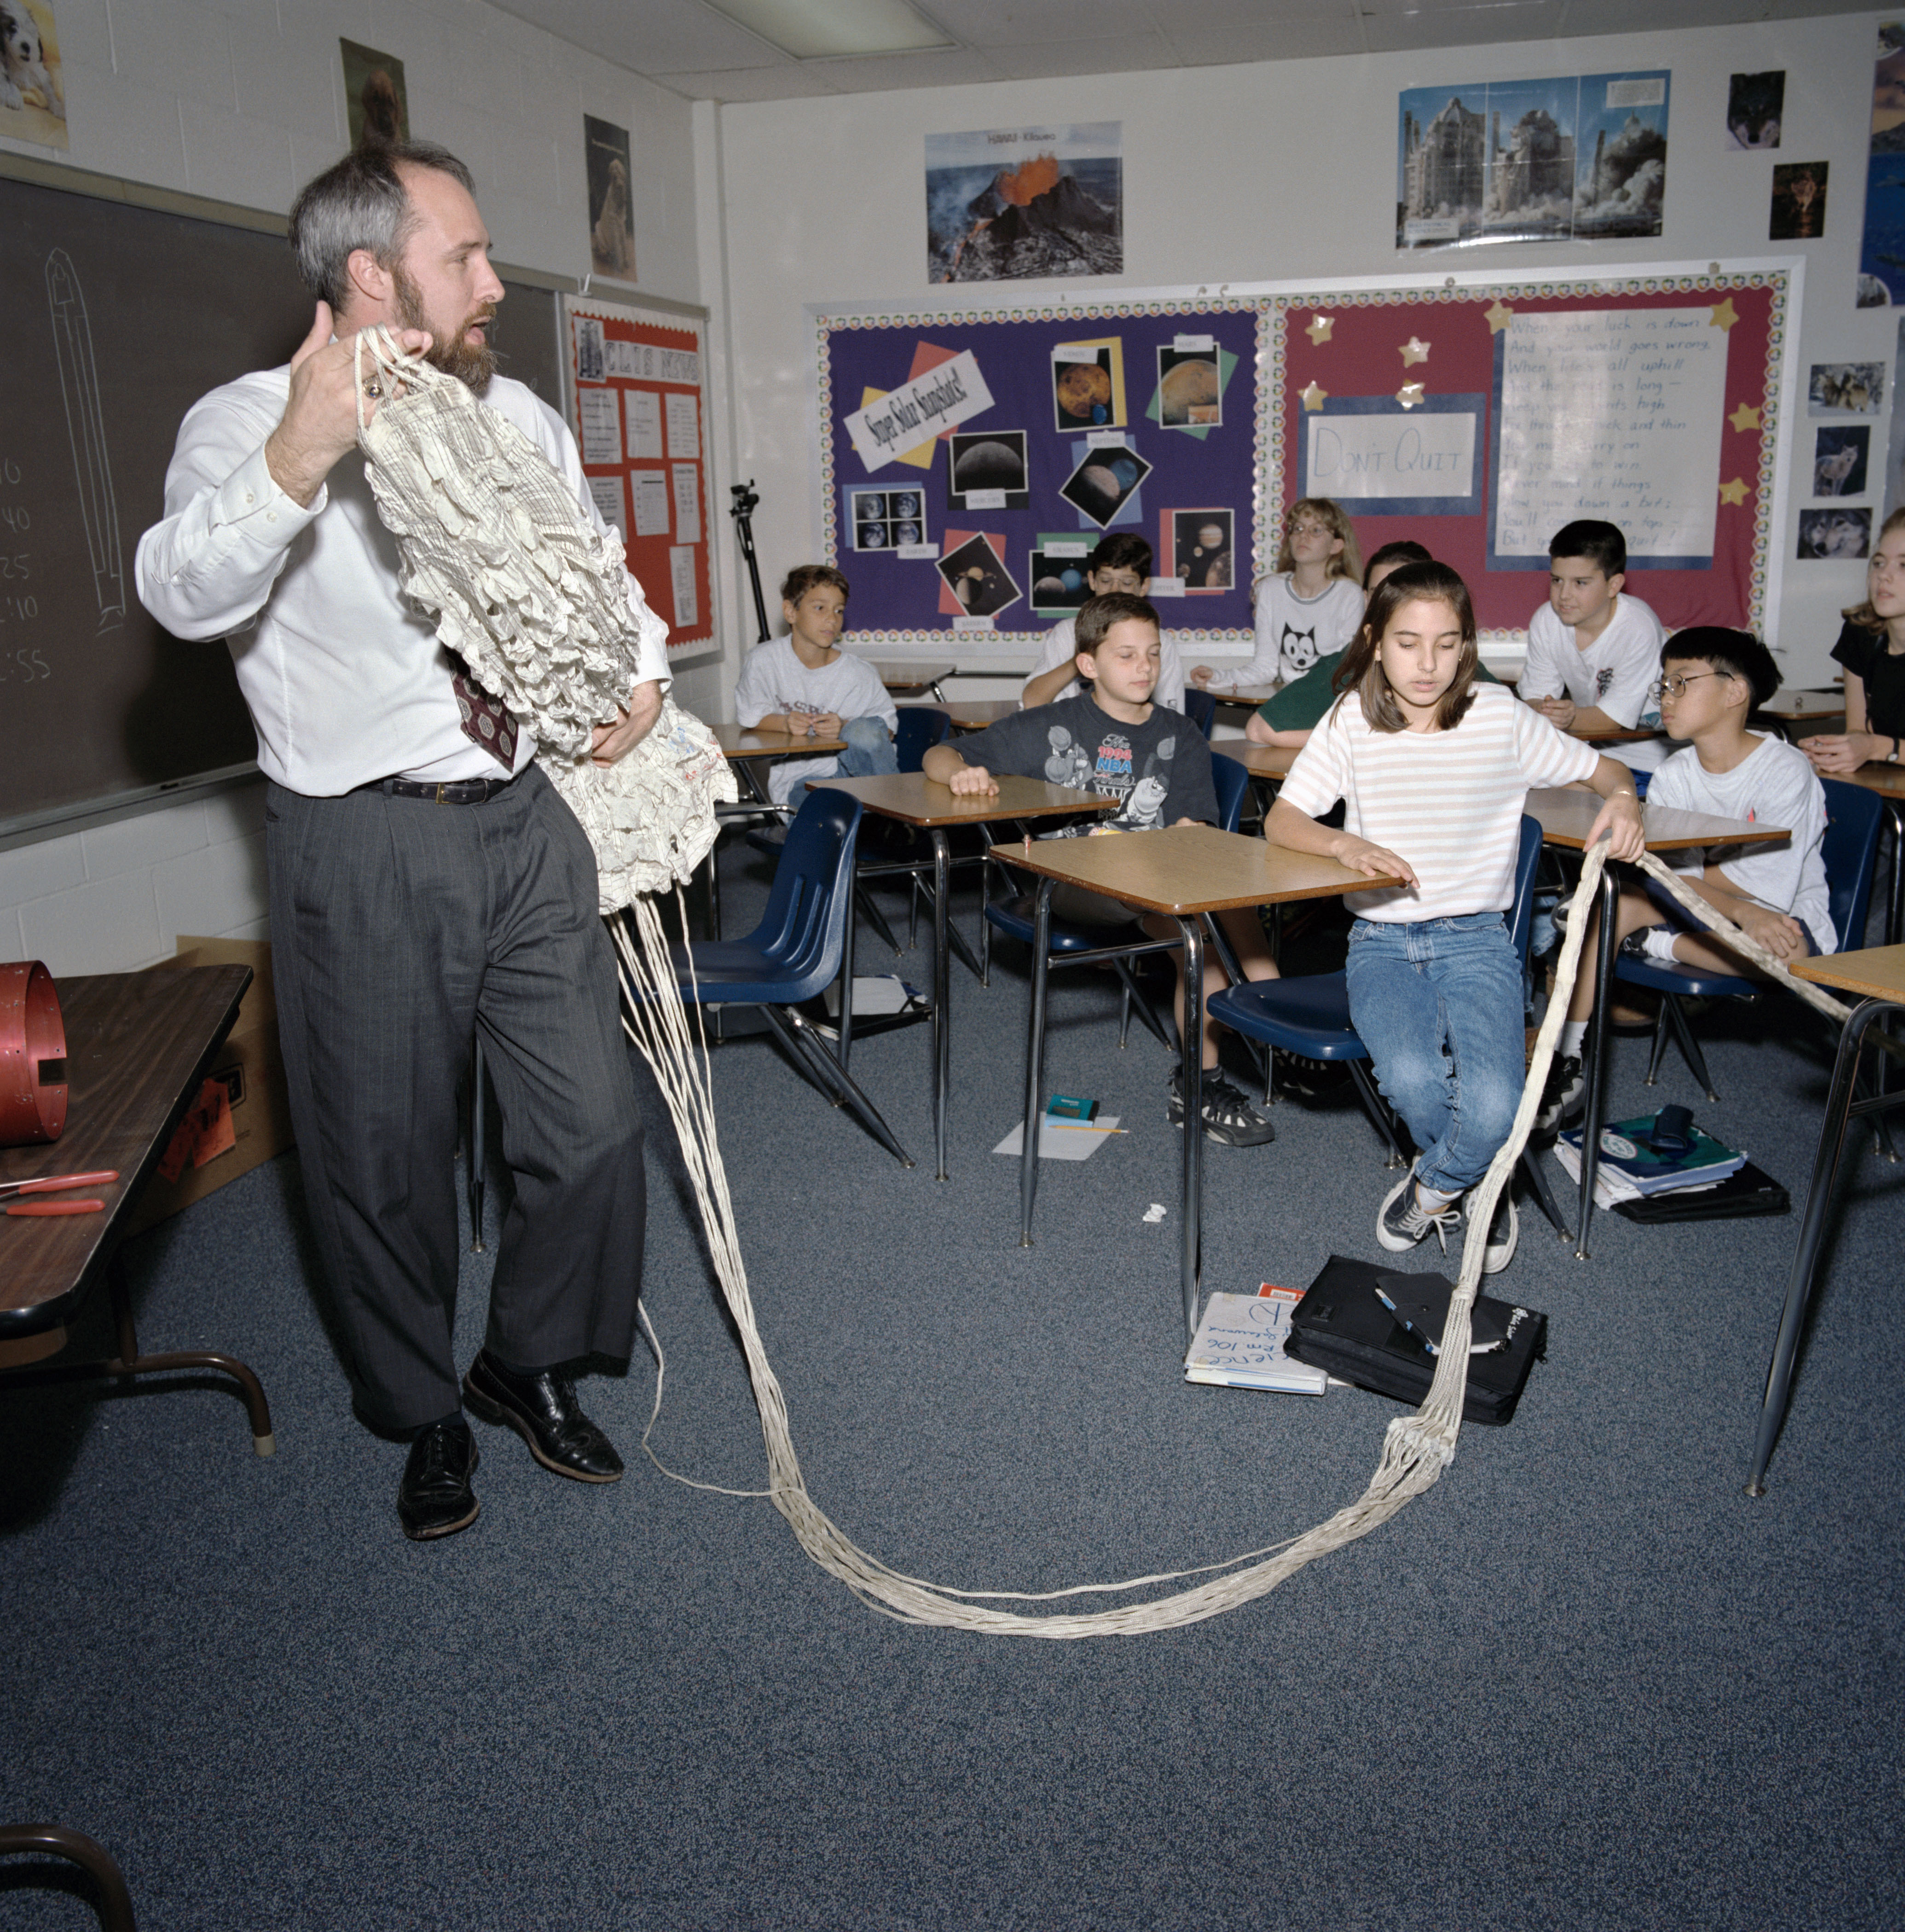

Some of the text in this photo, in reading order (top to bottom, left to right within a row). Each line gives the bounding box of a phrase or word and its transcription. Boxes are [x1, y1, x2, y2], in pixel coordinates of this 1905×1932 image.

[1605, 315, 1632, 331] luck
[1646, 320, 1657, 329] is
[1664, 317, 1700, 329] down
[1511, 340, 1535, 354] And
[1628, 342, 1658, 354] goes
[1509, 358, 1547, 373] When
[1607, 357, 1629, 371] all
[1640, 358, 1685, 373] uphill
[1612, 381, 1624, 391] is
[1636, 377, 1663, 395] long
[1636, 395, 1665, 413] high
[1629, 418, 1655, 431] and
[1661, 417, 1687, 429] thin
[1395, 427, 1462, 472] QUIT
[1623, 441, 1640, 450] on
[1611, 476, 1651, 493] things
[1574, 494, 1610, 508] down
[1102, 733, 1131, 749] The
[1098, 745, 1133, 761] 1994
[1095, 757, 1133, 774] NBA
[1206, 1339, 1238, 1351] 106
[1199, 1352, 1290, 1366] cience
